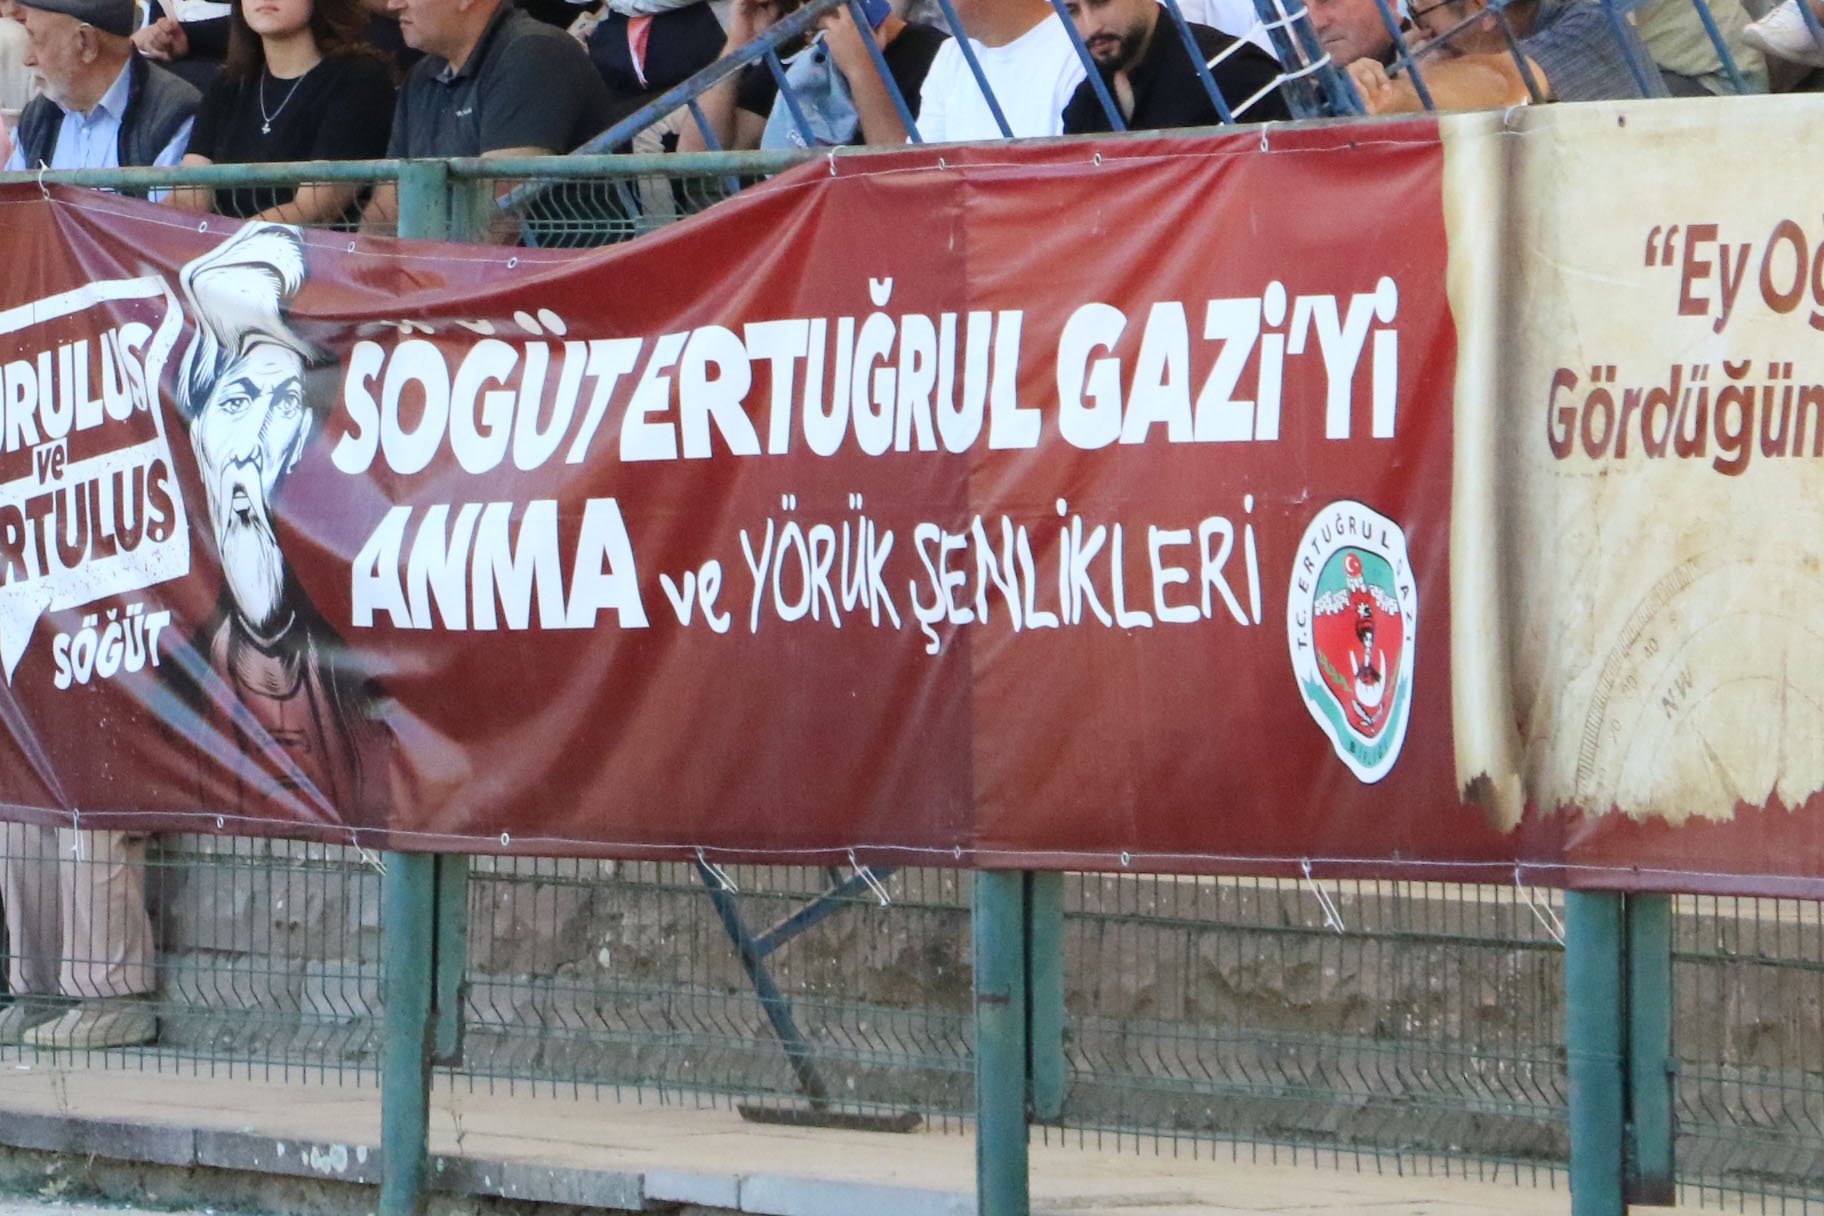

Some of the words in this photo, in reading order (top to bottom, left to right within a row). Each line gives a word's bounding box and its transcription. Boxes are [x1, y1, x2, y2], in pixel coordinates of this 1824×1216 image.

[620, 277, 1041, 462] ERTUĞRUL
[1057, 276, 1398, 449] GAZİ'Yİ
[36, 441, 65, 485] ve
[352, 497, 650, 630] ANMA
[659, 560, 731, 633] ve
[740, 493, 901, 634] YÖRÜK
[909, 494, 1262, 655] ŞENLİKLERİ
[1298, 513, 1390, 595] ERTUĞRUL
[52, 602, 171, 690] SÖĞÜT
